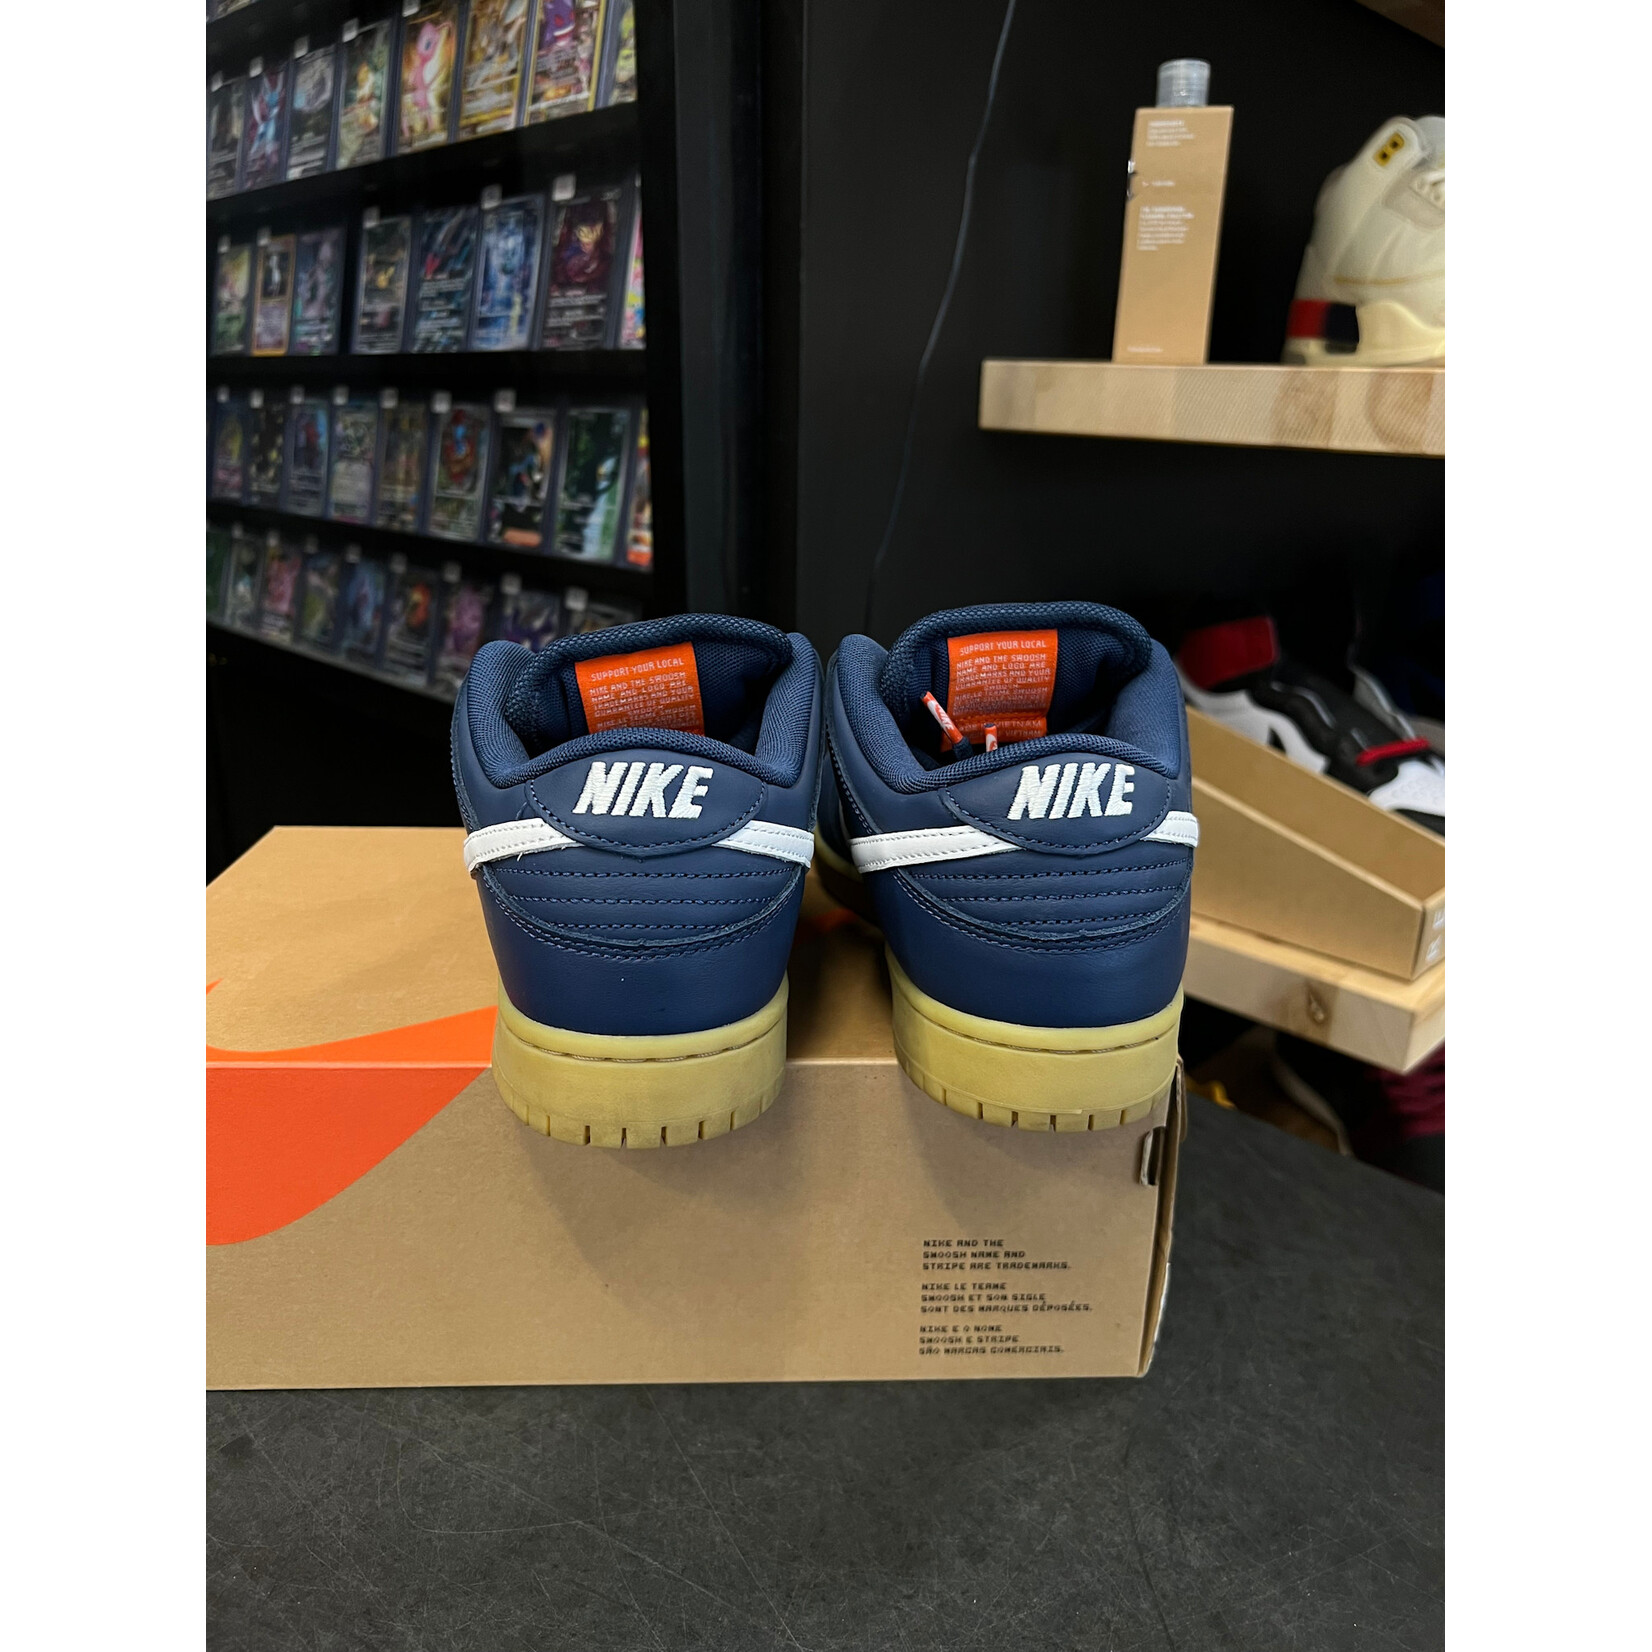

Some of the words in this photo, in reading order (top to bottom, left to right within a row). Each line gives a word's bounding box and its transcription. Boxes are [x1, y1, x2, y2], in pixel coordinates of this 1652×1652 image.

[960, 642, 994, 656] SUPPORT
[996, 640, 1019, 650] YOUR
[1021, 640, 1047, 649] LOCAL
[956, 659, 973, 670] NIKE
[974, 656, 991, 664] AND
[1011, 653, 1046, 662] SWOOSH
[591, 666, 630, 682] SUPPORT
[631, 661, 655, 674] YOUR
[656, 657, 684, 669] LOCAL
[956, 667, 978, 677] NAME
[1009, 669, 1026, 677] AND
[1028, 668, 1051, 676] YOUR
[589, 685, 609, 696] NIKE
[610, 682, 628, 692] AND
[630, 678, 646, 687] THE
[649, 671, 686, 684] SWOOSH
[591, 693, 615, 702] NAME
[620, 688, 637, 697] AND
[642, 683, 665, 693] LOGO
[669, 680, 687, 688] ARE
[650, 689, 668, 698] AND
[670, 685, 694, 695] YOUR
[572, 760, 714, 820] NIKE
[1006, 762, 1136, 820] NIKE
[923, 1239, 953, 1247] NIKE
[956, 1239, 978, 1247] AND
[983, 1239, 1004, 1247] THE
[922, 1251, 967, 1259] SWOOSH
[1003, 1250, 1026, 1258] AND
[922, 1262, 966, 1270] STRIPE
[969, 1262, 992, 1270] ARE
[996, 1261, 1071, 1270] TRADEMARKS.
[921, 1283, 950, 1291] NIKE
[972, 1282, 1007, 1290] TERME
[921, 1294, 965, 1302] SWOOSH
[1011, 1293, 1046, 1301] SIGLE
[920, 1305, 949, 1313] SONT
[953, 1305, 974, 1313] DES
[978, 1304, 1028, 1313] MARQUES
[919, 1325, 948, 1333] NIKE
[919, 1336, 962, 1344] SWOOSH
[977, 1335, 1019, 1343] STRIPE
